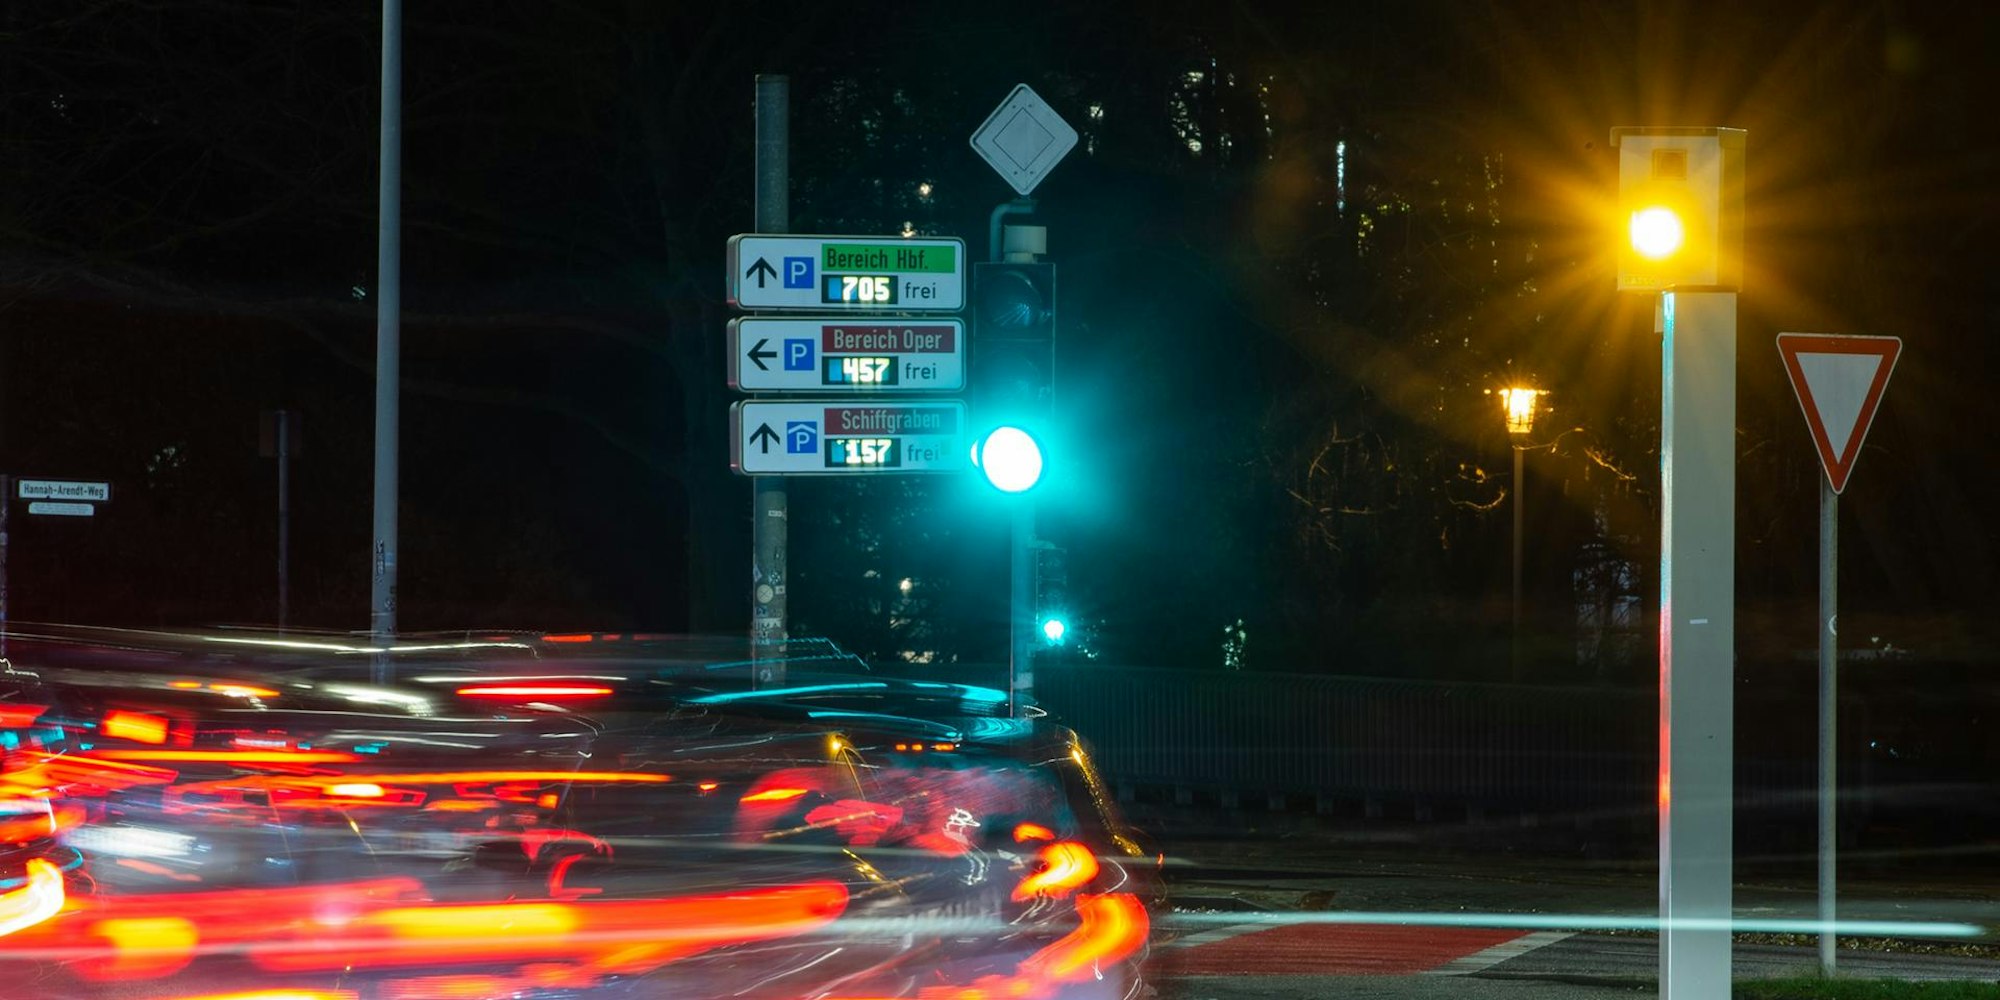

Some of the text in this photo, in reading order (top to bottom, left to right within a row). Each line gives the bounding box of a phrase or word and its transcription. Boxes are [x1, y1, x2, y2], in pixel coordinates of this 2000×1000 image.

[827, 248, 929, 269] Bereich Hbf.
[791, 261, 807, 285] P
[842, 276, 936, 301] 705 frei
[834, 329, 942, 353] Bereich Oper
[791, 343, 807, 366] P
[843, 357, 937, 383] 457 frei
[841, 410, 940, 434] Schiffgraben
[844, 439, 939, 464] 157 frei
[24, 483, 104, 498] Hannah-Arendt-Weg
